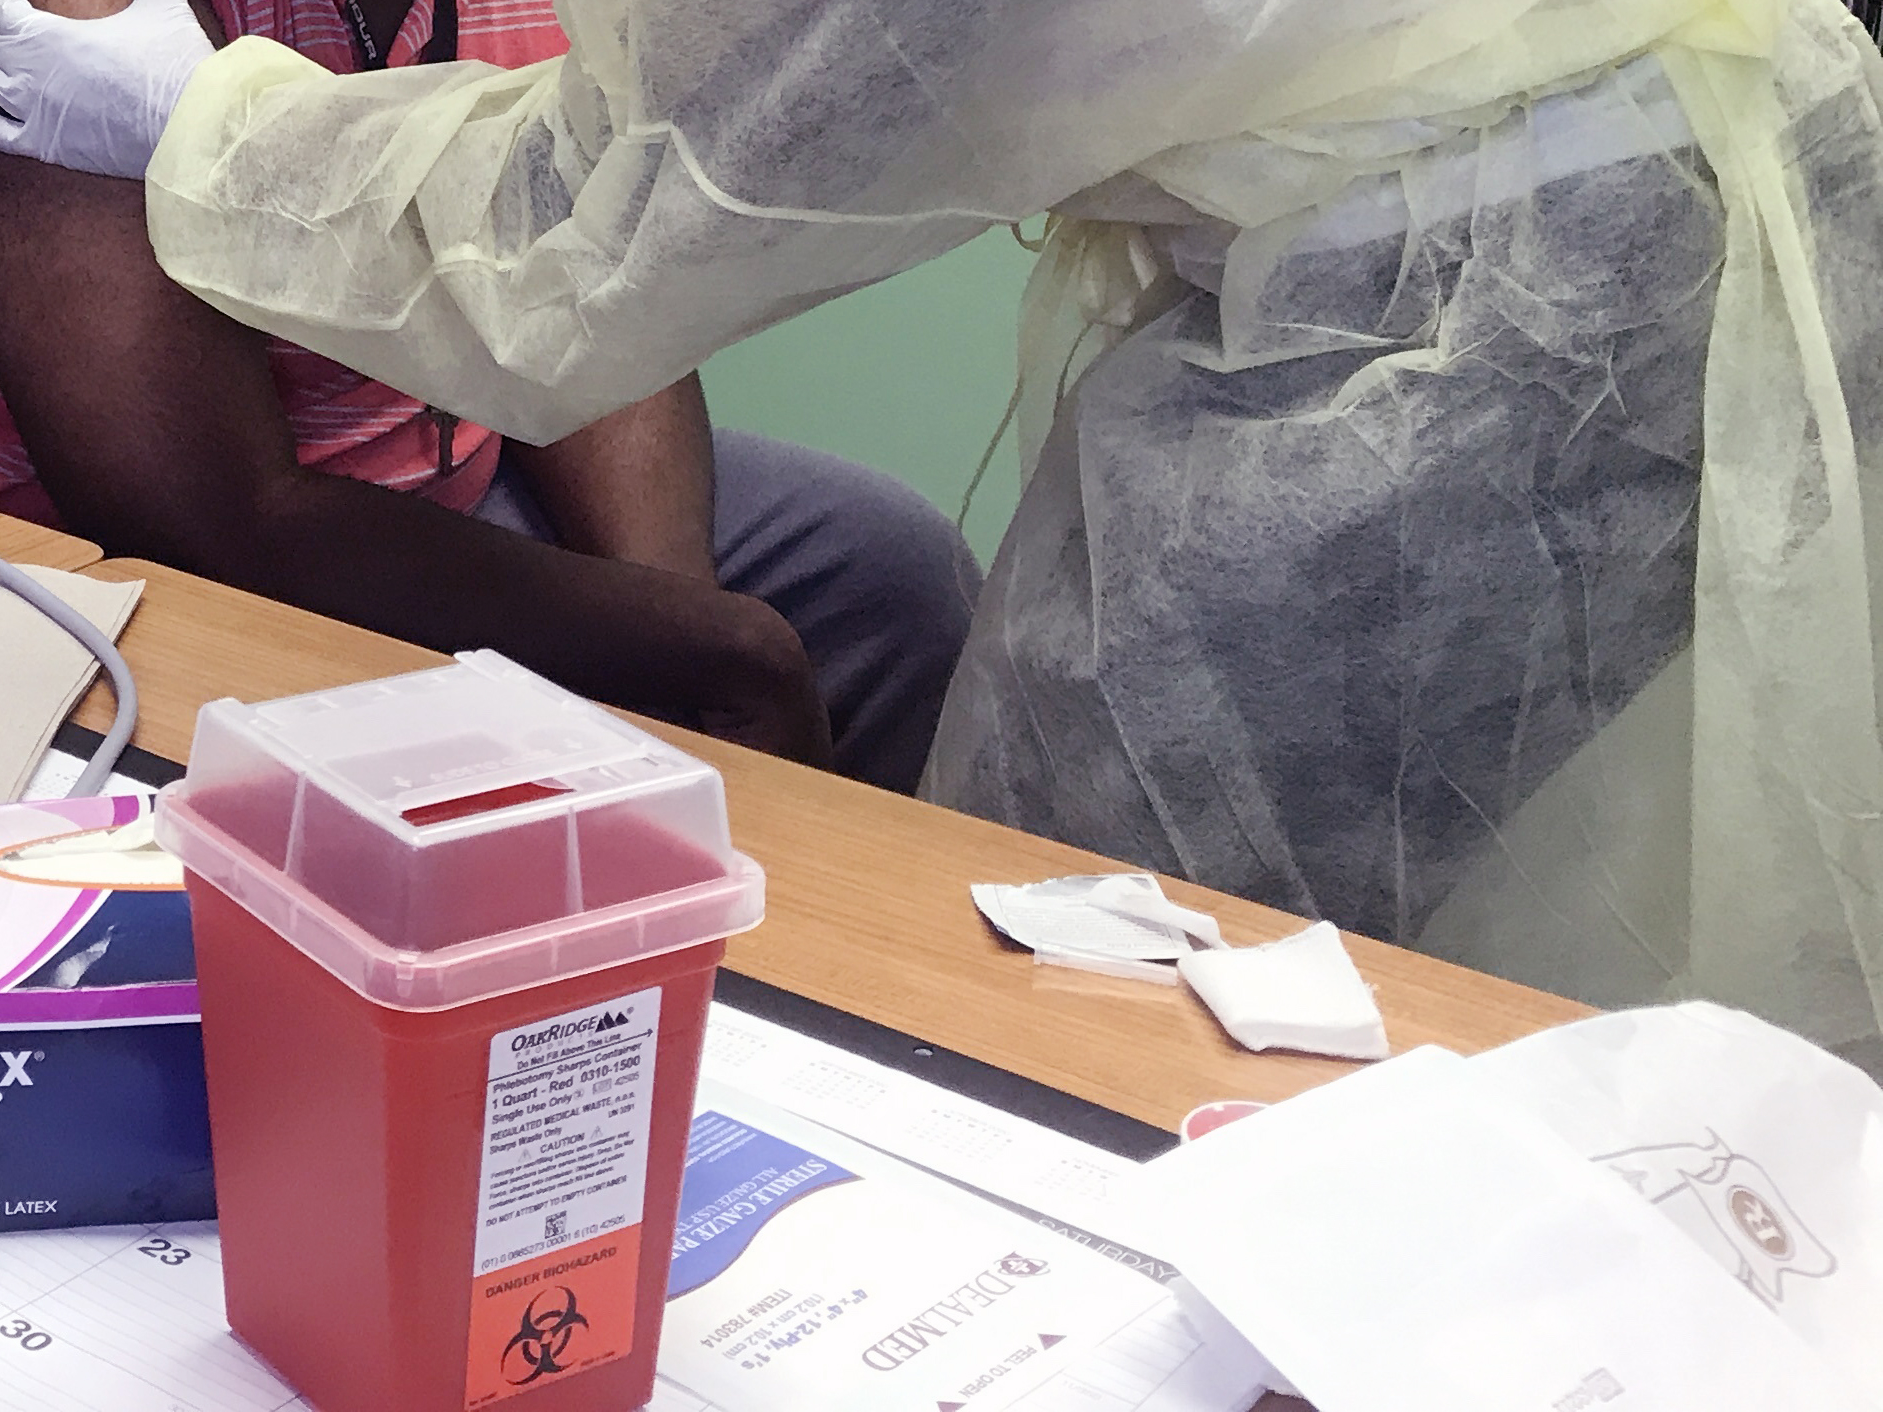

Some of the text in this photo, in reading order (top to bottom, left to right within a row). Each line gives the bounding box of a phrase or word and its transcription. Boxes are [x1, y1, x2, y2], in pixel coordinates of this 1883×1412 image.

[492, 1039, 642, 1097] Phlebotomy Sharps Container
[517, 1059, 529, 1070] Do
[530, 1054, 544, 1066] Not
[560, 1042, 585, 1057] Above
[491, 1090, 572, 1127] Single Use Only
[492, 1099, 498, 1109] 1
[502, 1086, 538, 1108] Quart
[549, 1075, 573, 1093] Red
[489, 1124, 562, 1156] Sharps Waste Only
[490, 1117, 542, 1143] REGULATED
[544, 1105, 580, 1126] MEDICAL
[539, 1131, 585, 1154] CAUTION
[715, 1182, 757, 1207] GAUZE
[749, 1158, 827, 1206] STERILE
[5, 1200, 58, 1216] LATEX
[690, 1201, 757, 1242] GAUZE
[138, 1238, 191, 1266] 23
[1038, 1219, 1179, 1280] SATURDAY
[485, 1246, 617, 1298] DANGER BIOHAZARD
[0, 1318, 53, 1352] 30
[700, 1288, 793, 1348] ITEM# 783014
[776, 1310, 797, 1324] cm
[861, 1269, 1016, 1372] DEALMED
[958, 1344, 1037, 1398] PEEL TO OPEN
